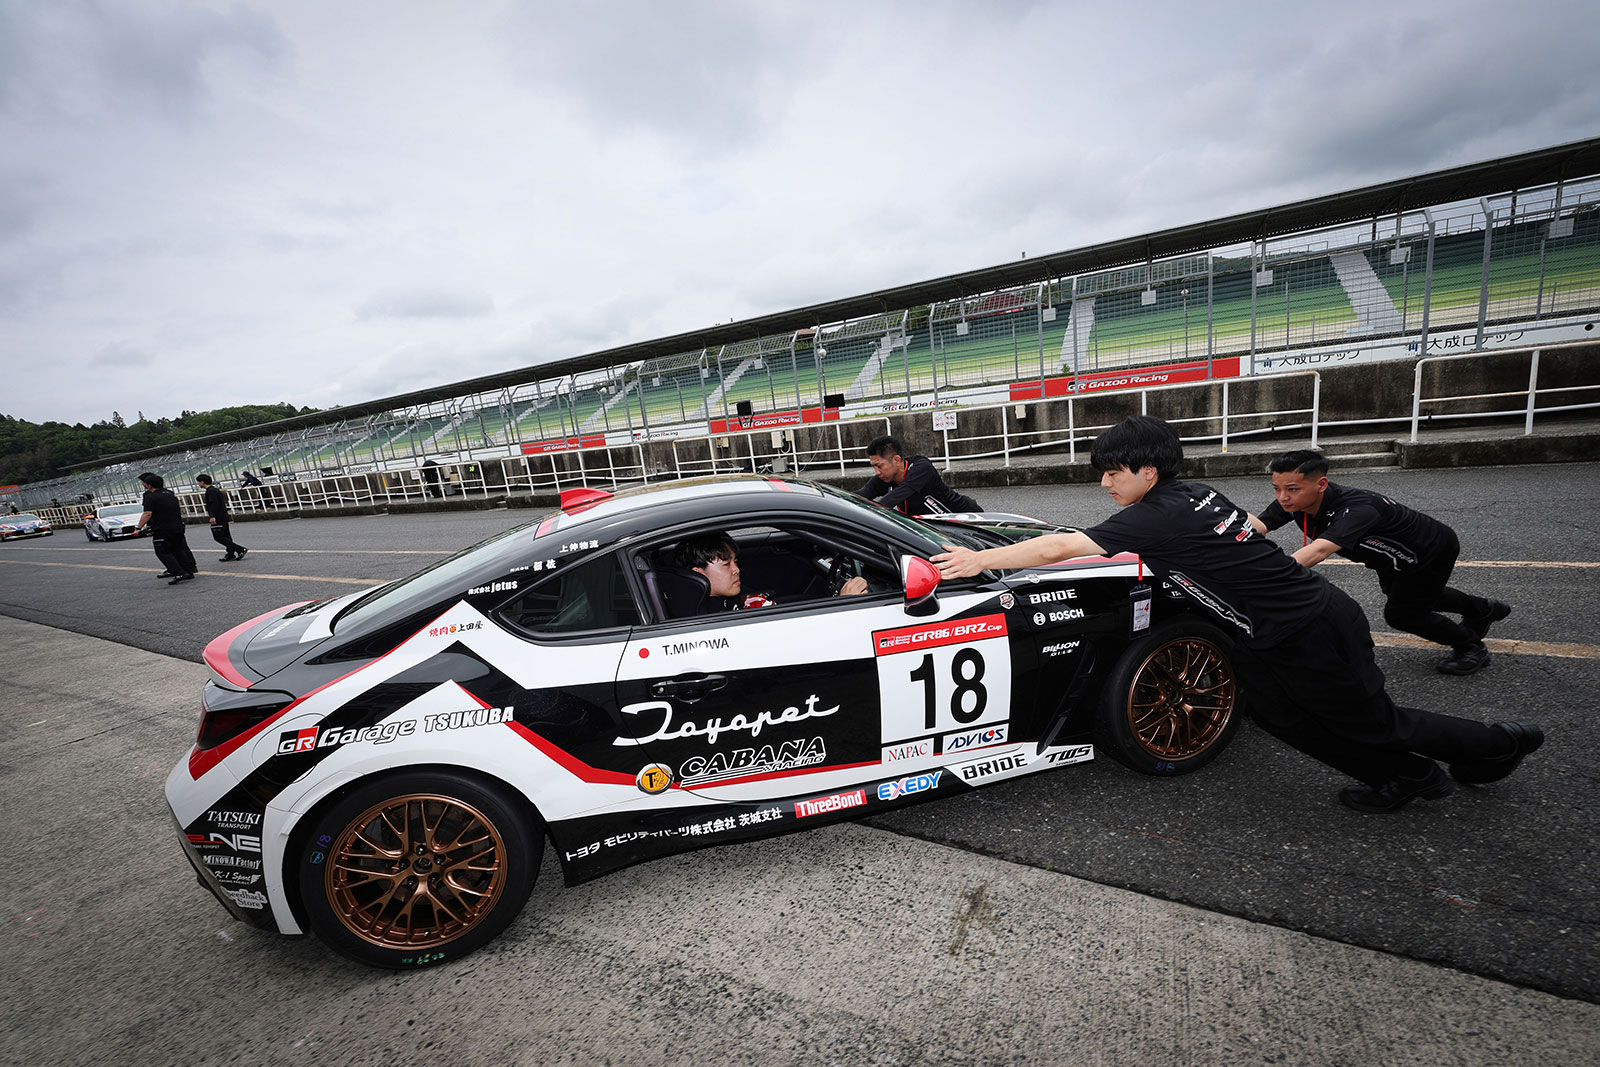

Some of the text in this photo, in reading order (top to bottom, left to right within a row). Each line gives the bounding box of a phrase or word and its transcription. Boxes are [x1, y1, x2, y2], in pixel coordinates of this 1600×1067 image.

[1129, 374, 1168, 383] Racing
[929, 399, 958, 407] Rcing
[1029, 589, 1077, 604] BRIDE
[1049, 608, 1084, 621] BOSCH
[911, 622, 987, 643] GR86/BRZ
[662, 638, 730, 656] T.MINOWA
[1042, 640, 1080, 653] BILLION
[910, 648, 988, 730] 18
[612, 694, 840, 746] Toyopet
[278, 706, 514, 754] GR Garage TSUKUBA
[947, 728, 1004, 750] ADVICS
[680, 736, 826, 778] CABANA
[888, 743, 928, 762] NAPAC
[1045, 745, 1092, 763] TWS
[961, 753, 1028, 780] BRIDE
[878, 771, 942, 800] EXEDY
[797, 791, 862, 816] ThreeBond
[207, 811, 261, 825] TATSUKI
[217, 822, 251, 830] TRANSPORT
[566, 841, 600, 862] トヨタ
[738, 807, 783, 826] 茨城支社
[203, 855, 234, 867] MINOWA
